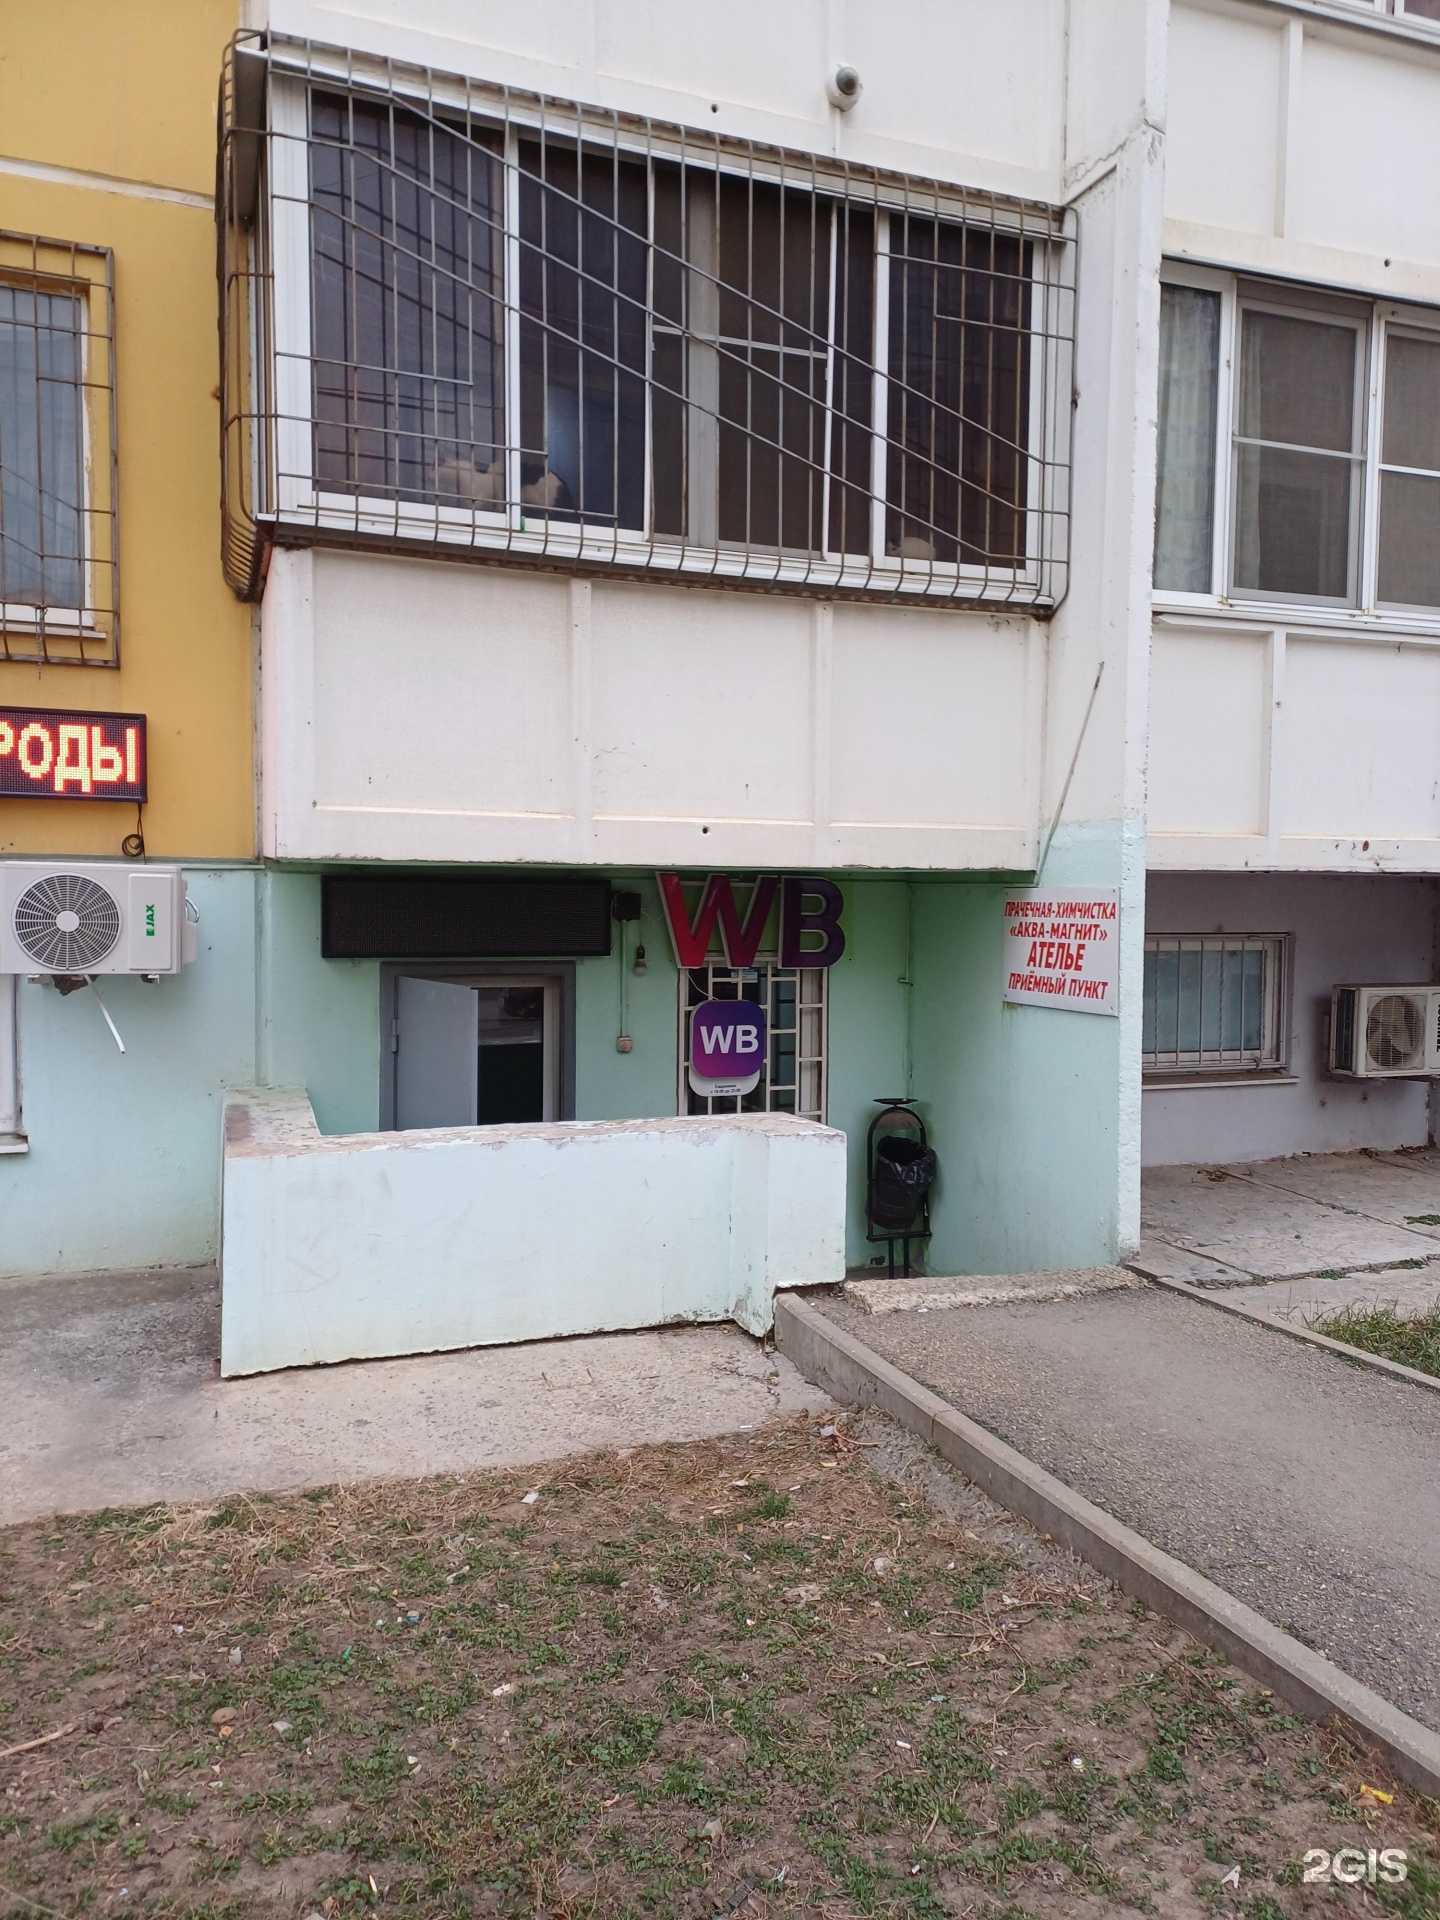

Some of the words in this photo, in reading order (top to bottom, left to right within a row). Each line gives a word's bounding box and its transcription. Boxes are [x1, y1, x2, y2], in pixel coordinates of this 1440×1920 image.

[656, 872, 846, 969] WB
[1004, 901, 1116, 919] ПРАЧЕЧНАЯ-ХИМЧИСТКА
[1010, 922, 1108, 941] «АКВА-МАГНИТ»
[1027, 941, 1086, 971] АТЕЛЬЕ
[1008, 971, 1067, 995] ПРИЁМНЫЙ
[1068, 978, 1108, 1000] ПУНКТ
[700, 1025, 759, 1055] WB
